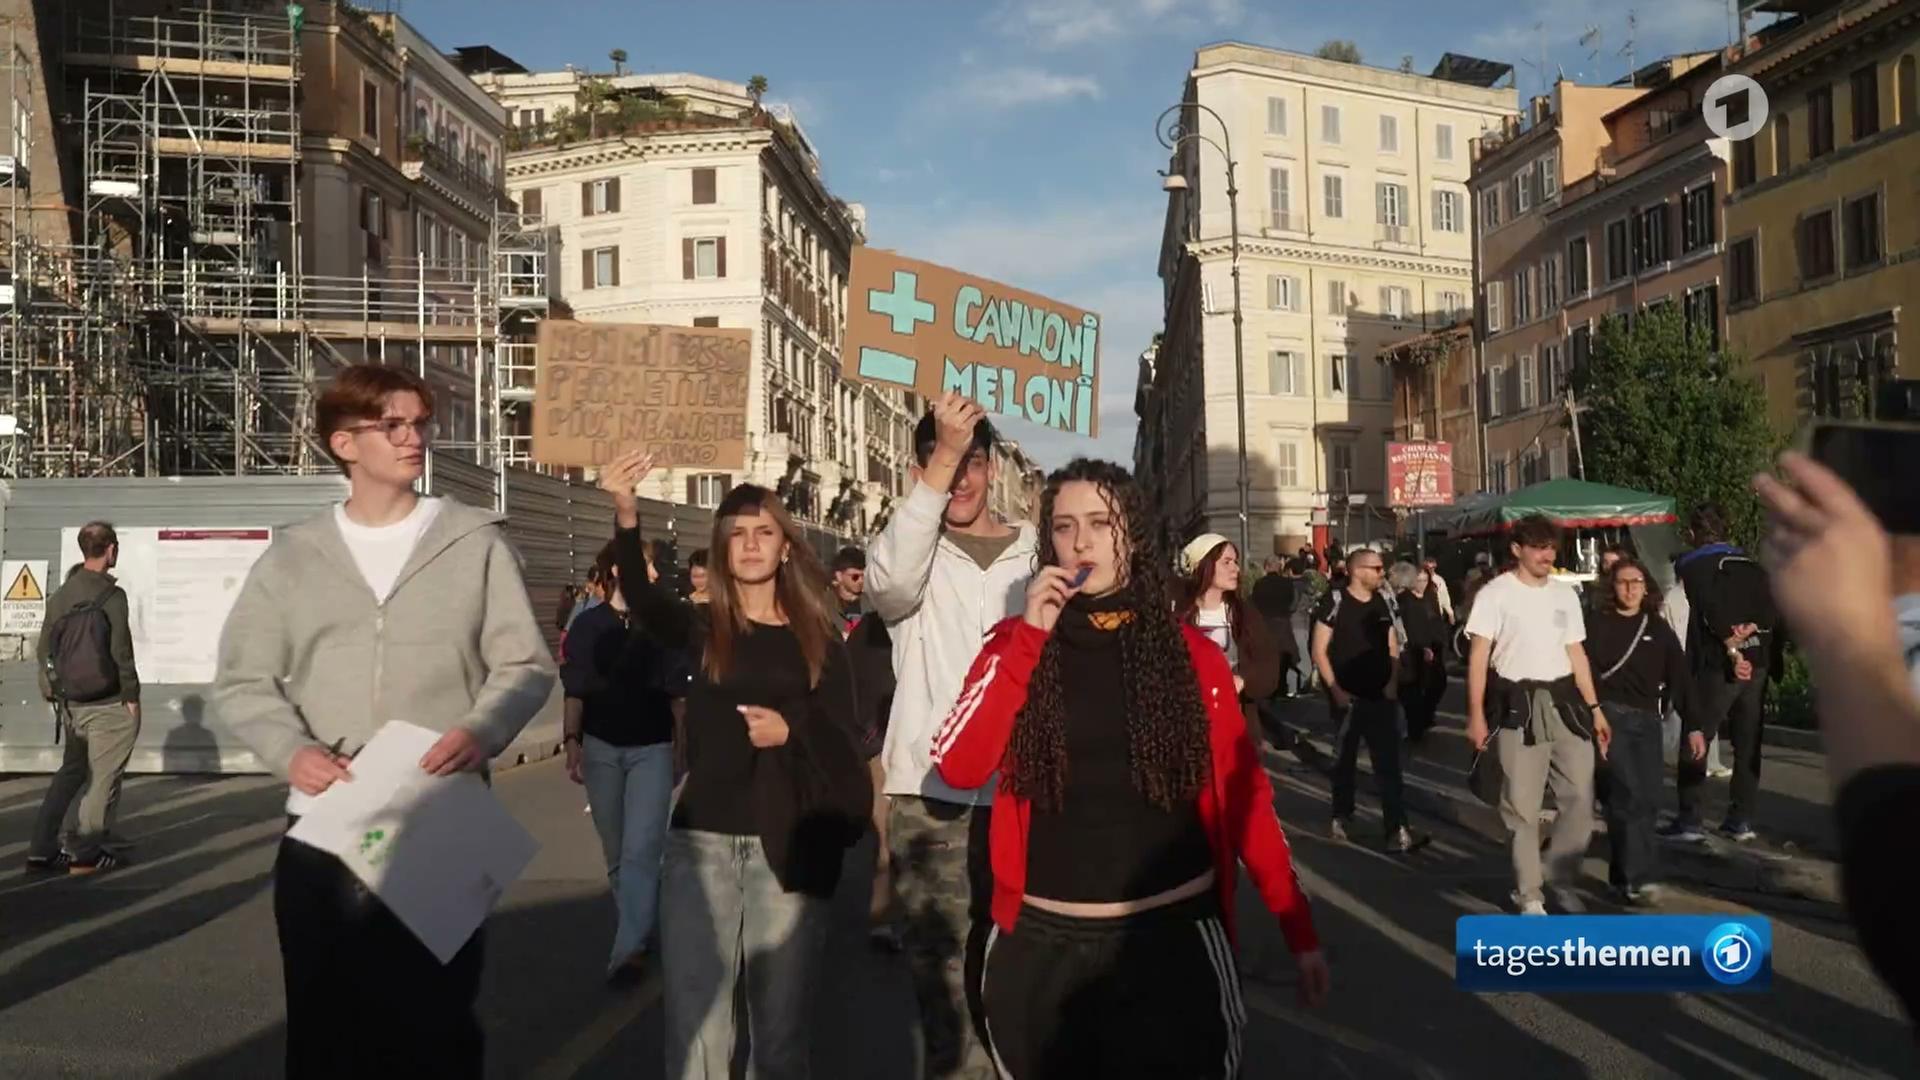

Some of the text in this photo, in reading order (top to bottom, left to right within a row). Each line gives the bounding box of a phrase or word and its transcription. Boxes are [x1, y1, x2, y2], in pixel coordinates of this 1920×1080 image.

[666, 333, 752, 374] POSSO
[953, 285, 1100, 377] CANNONI
[619, 408, 747, 441] NEANCHE
[942, 354, 1094, 437] MELONI
